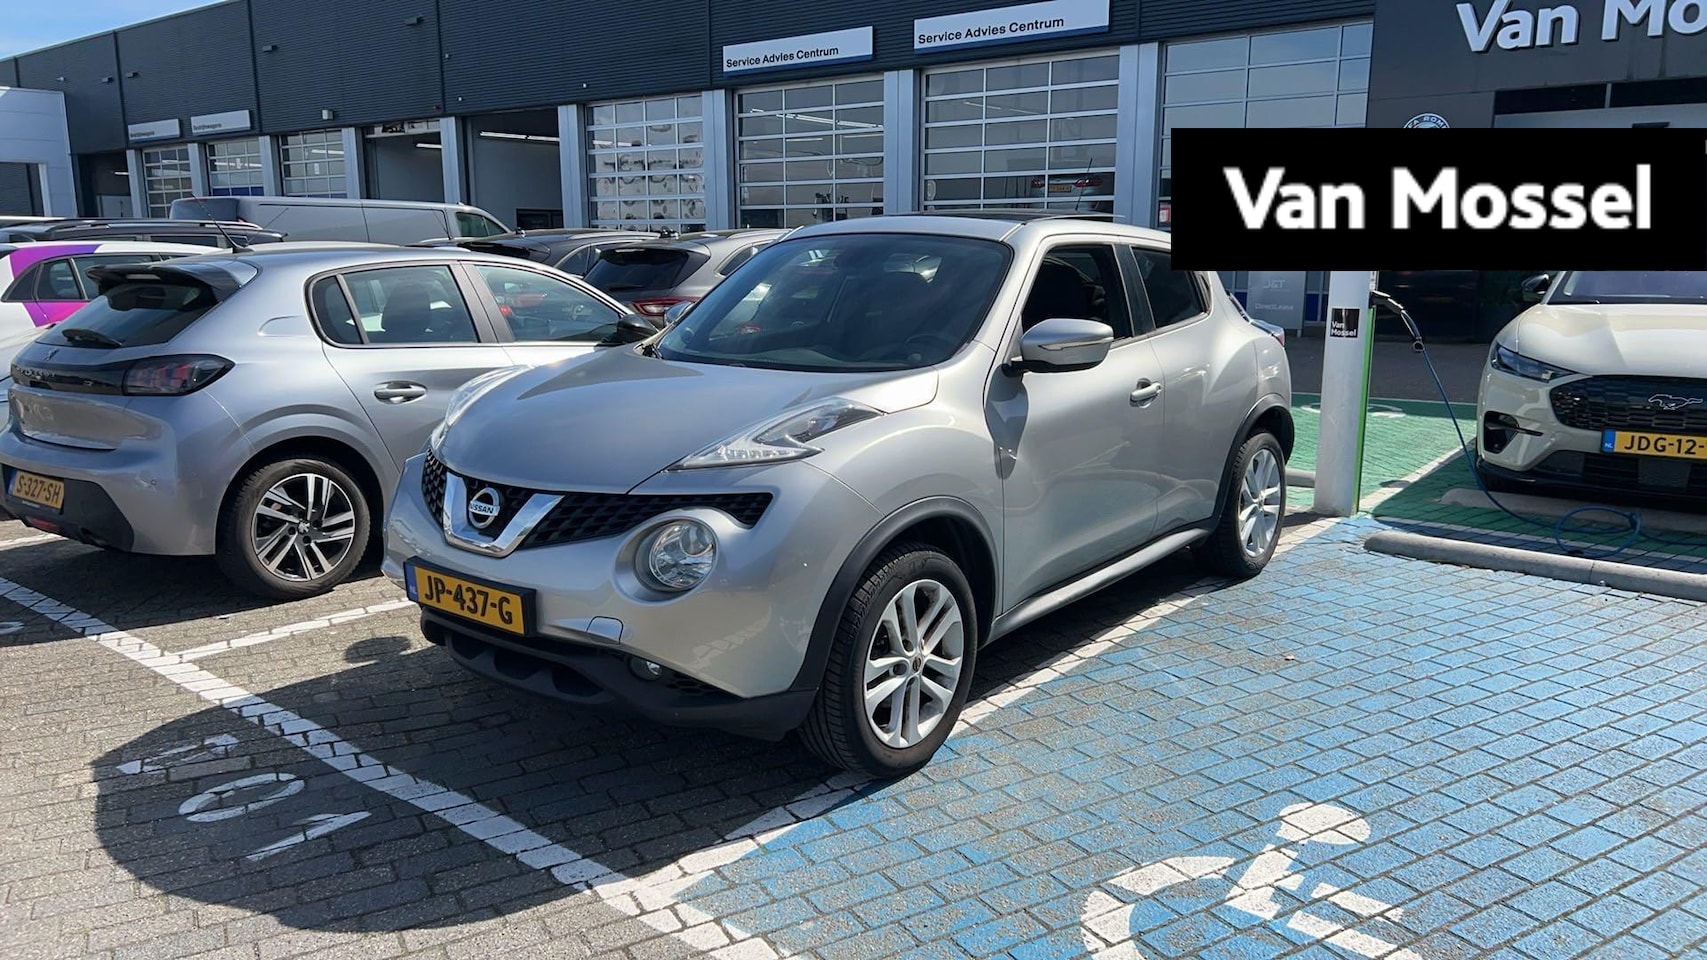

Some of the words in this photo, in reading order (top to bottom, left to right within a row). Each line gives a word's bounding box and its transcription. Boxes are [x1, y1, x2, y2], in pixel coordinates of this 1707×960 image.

[918, 31, 962, 44] Service
[965, 25, 1006, 38] Advies
[1009, 17, 1064, 33] Centrum
[1456, 0, 1579, 52] Van
[1601, 0, 1707, 40] Mo
[726, 57, 761, 68] Service
[762, 51, 794, 64] Advies
[796, 47, 839, 60] Centrum
[1330, 328, 1357, 337] Mossel
[1331, 320, 1345, 329] Van
[1624, 435, 1705, 455] JDG-12-
[16, 474, 62, 505] S-327-SH
[424, 575, 513, 625] JP-437-G
